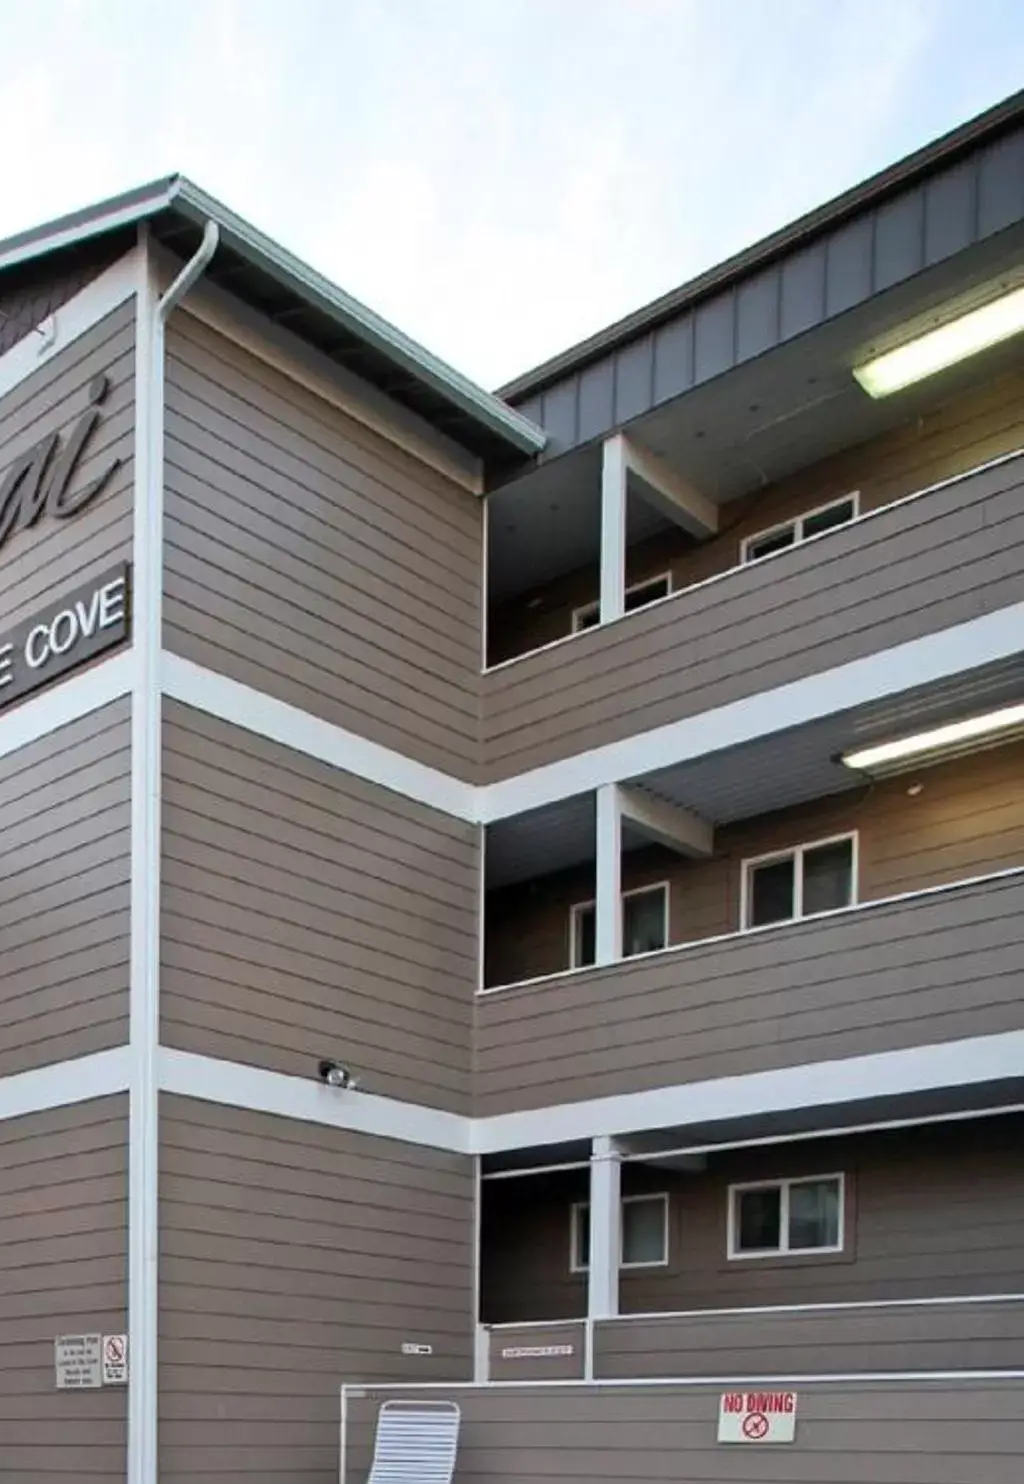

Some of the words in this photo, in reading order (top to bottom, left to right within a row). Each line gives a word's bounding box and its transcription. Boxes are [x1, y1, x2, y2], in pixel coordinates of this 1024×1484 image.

[25, 577, 125, 668] COVE
[724, 1393, 743, 1413] NO
[747, 1393, 793, 1413] DIVING
